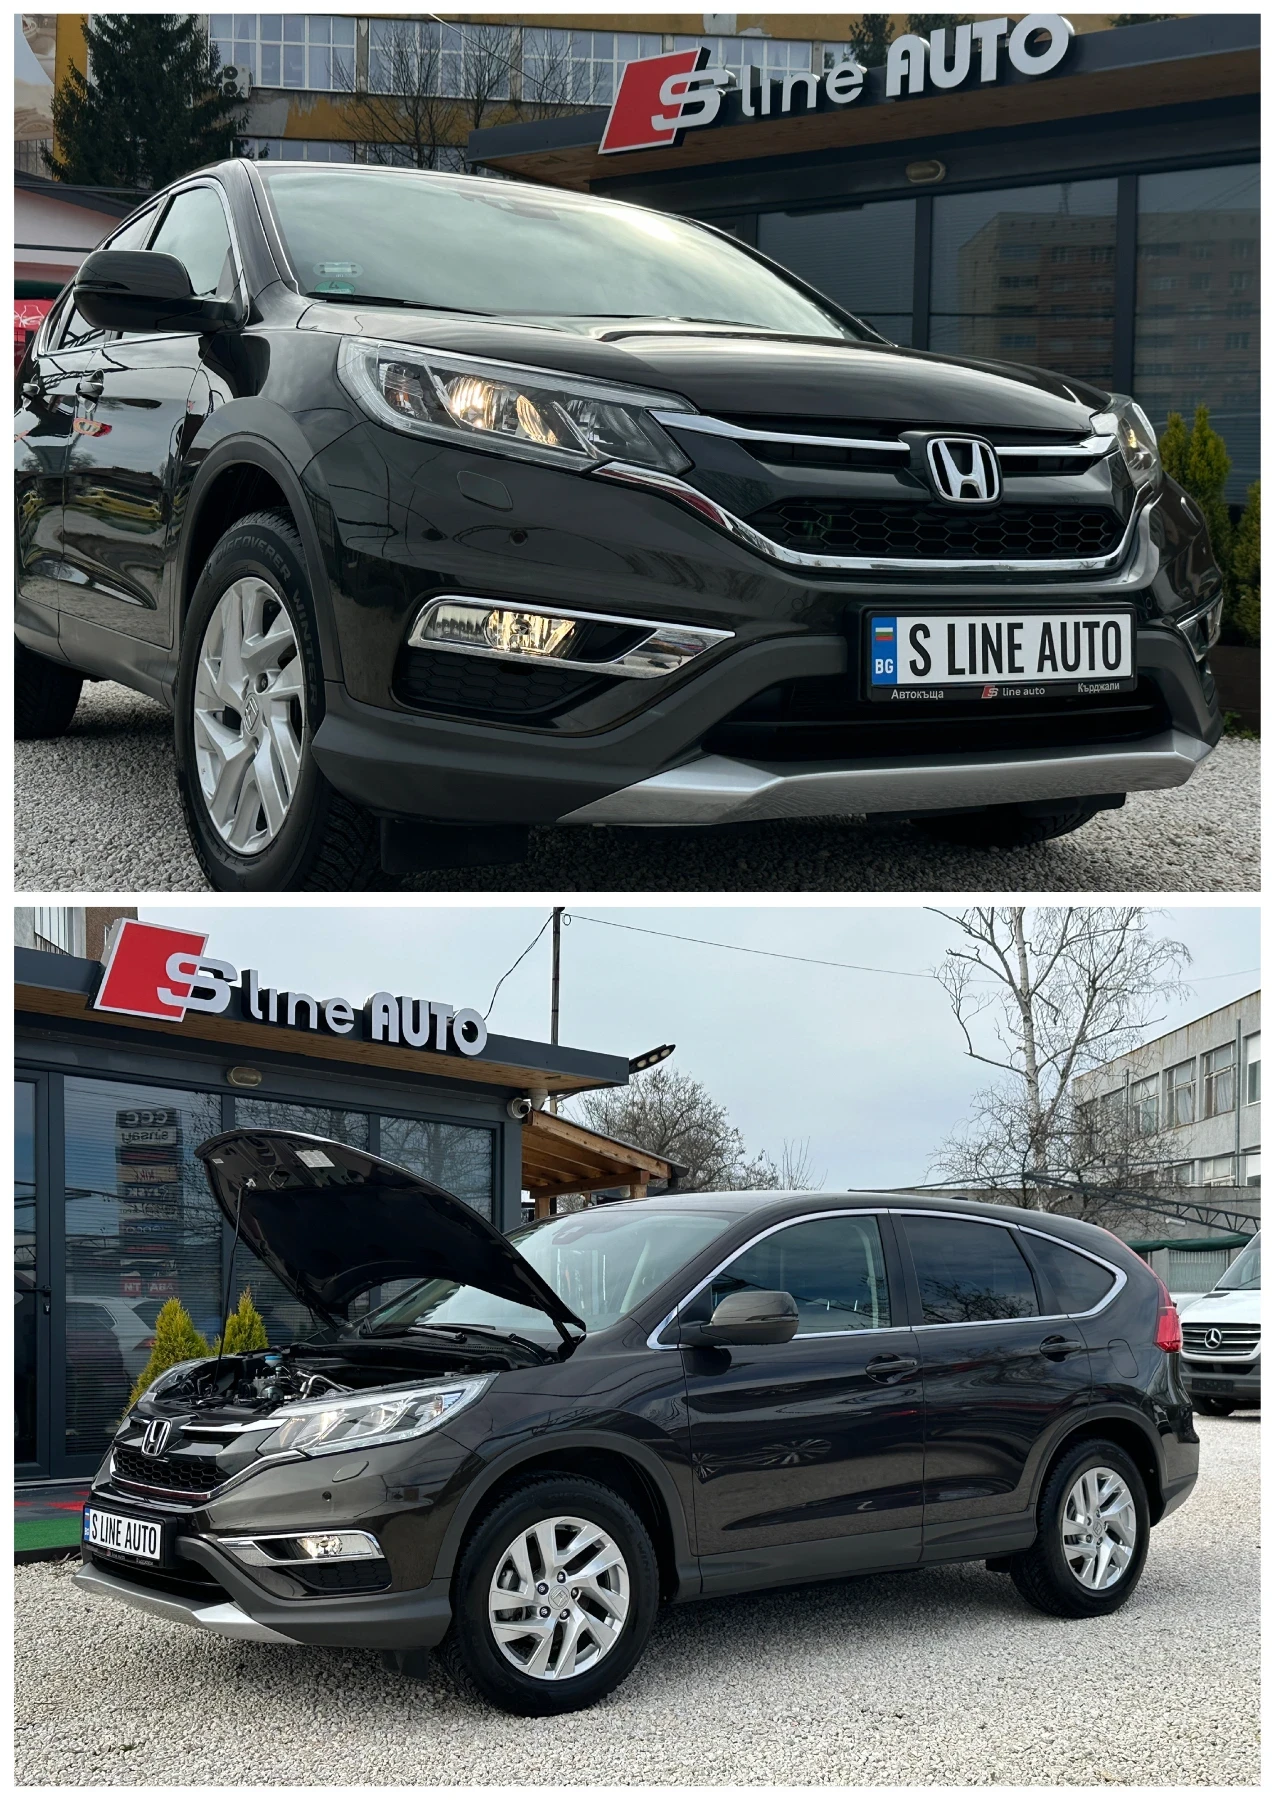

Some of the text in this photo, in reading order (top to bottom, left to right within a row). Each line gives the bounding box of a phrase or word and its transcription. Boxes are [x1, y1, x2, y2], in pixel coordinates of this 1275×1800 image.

[651, 13, 1069, 131] S line AUTO
[216, 535, 318, 707] DISCOVERER WINTER
[875, 658, 894, 674] BG
[908, 620, 1122, 677] S LINE AUTO
[891, 689, 944, 700] Автокъща
[1002, 687, 1022, 697] line
[1023, 686, 1046, 696] auto
[1077, 682, 1120, 694] Кърджали
[157, 952, 488, 1056] S line AUTO
[92, 1513, 157, 1555] S LINE AUTO
